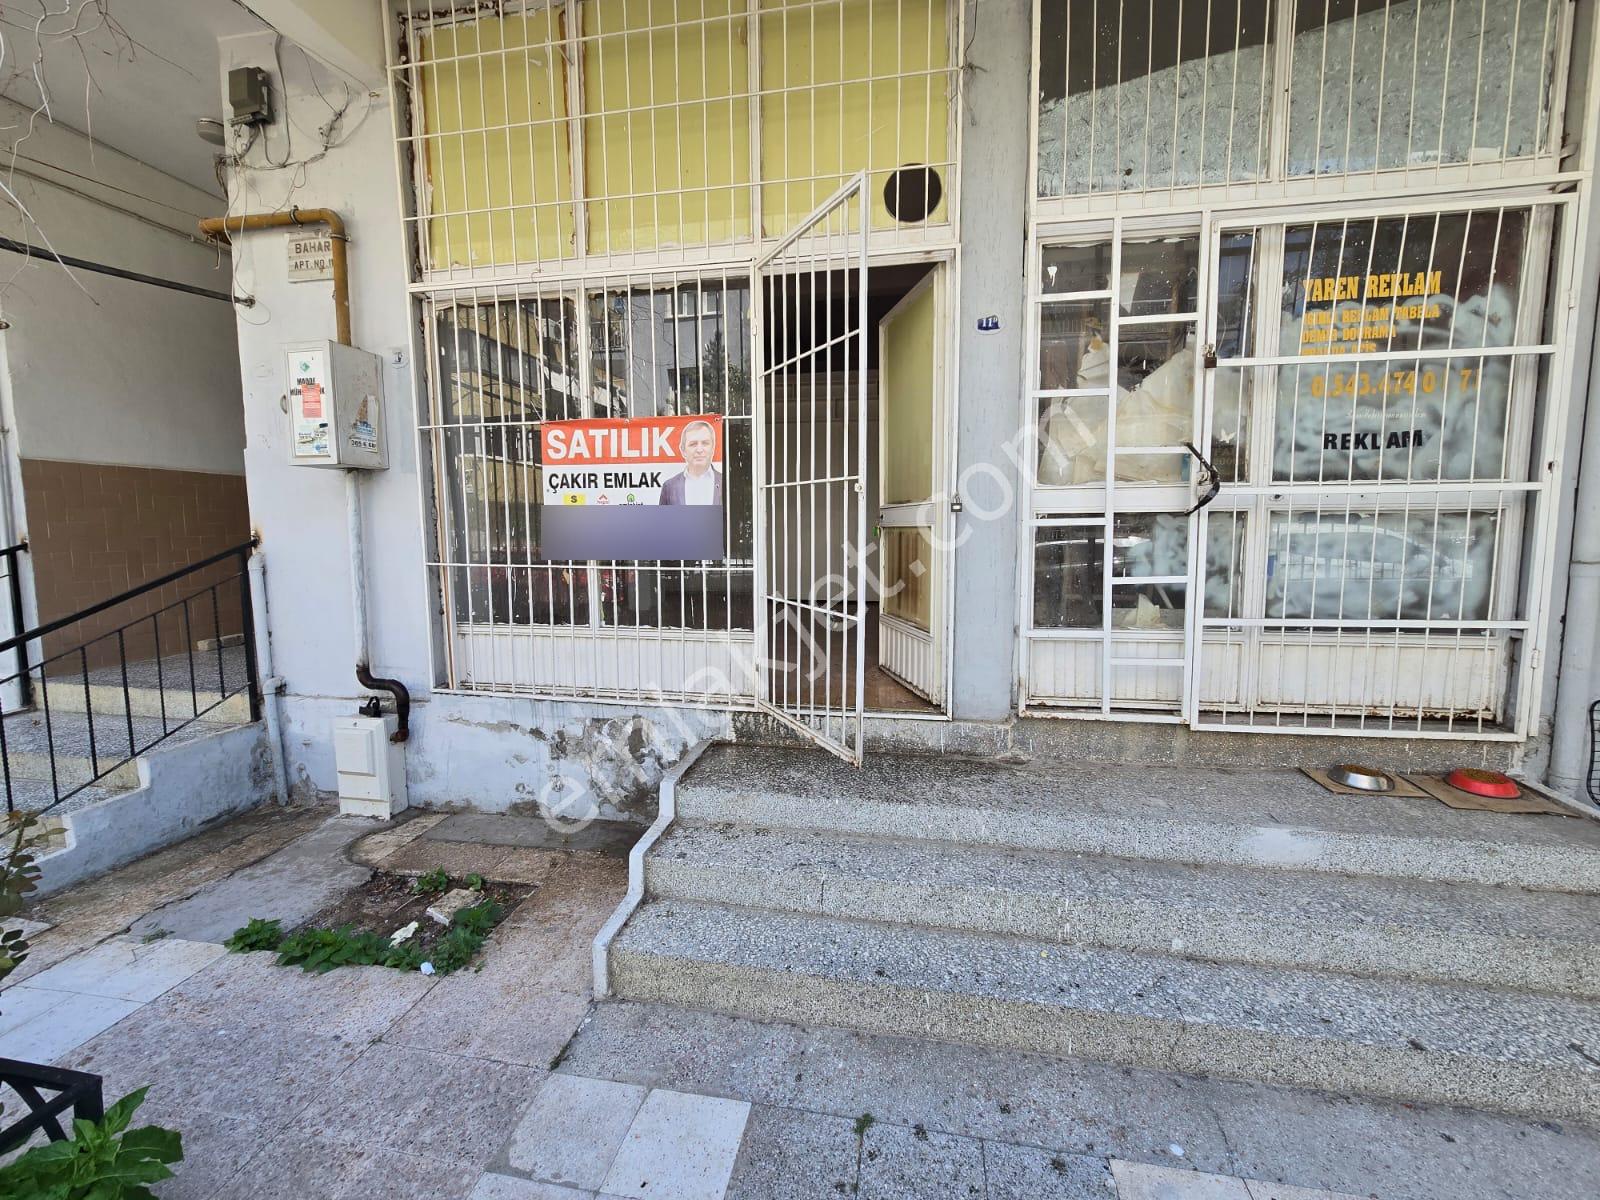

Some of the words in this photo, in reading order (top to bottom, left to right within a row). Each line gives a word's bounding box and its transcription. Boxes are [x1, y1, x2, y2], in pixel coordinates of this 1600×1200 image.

[295, 241, 330, 254] BAHAR
[1303, 275, 1359, 302] YAREN
[1366, 271, 1442, 298] REKLAM
[547, 426, 677, 460] SATILIK
[1323, 430, 1424, 450] REKLAM
[548, 473, 598, 494] ÇAKIR
[604, 471, 662, 489] EMLAK
[571, 494, 578, 503] S
